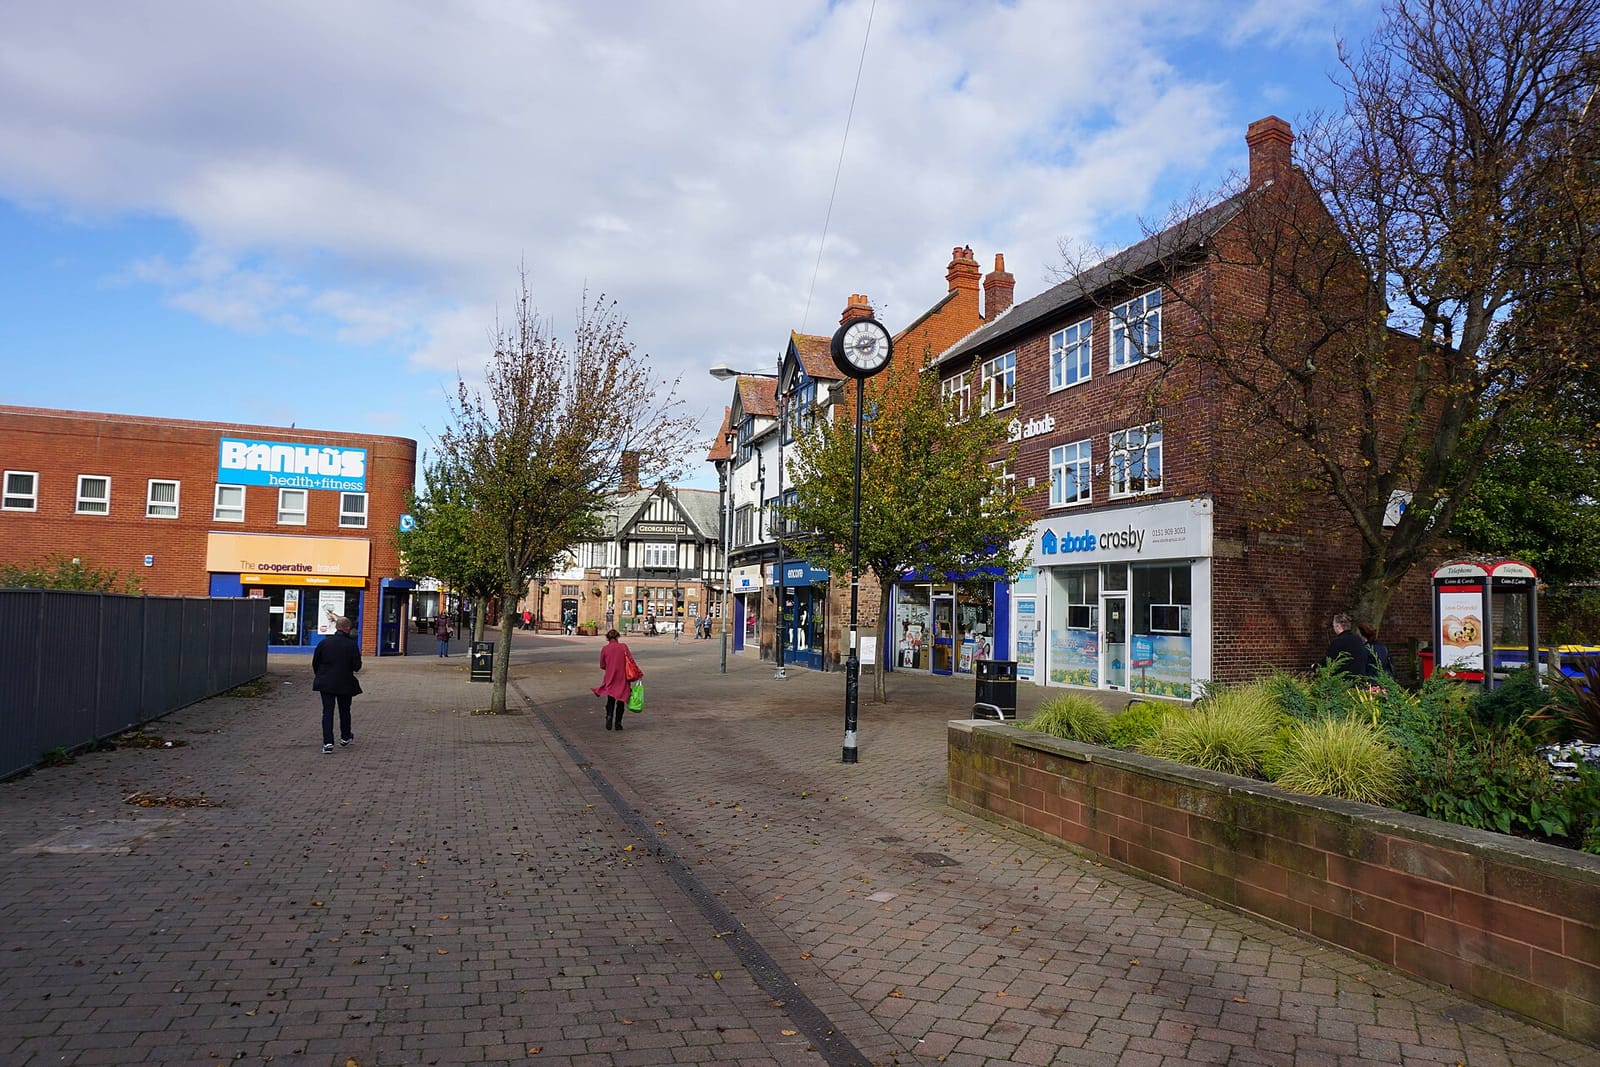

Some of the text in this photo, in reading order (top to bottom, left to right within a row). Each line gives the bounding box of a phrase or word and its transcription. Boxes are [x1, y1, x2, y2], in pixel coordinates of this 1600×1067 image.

[1023, 413, 1055, 438] abode
[269, 474, 363, 490] health+fitness
[639, 525, 664, 533] GEORGE
[1060, 529, 1097, 554] abode
[1099, 524, 1145, 553] crosby
[240, 560, 255, 570] The
[258, 562, 312, 573] co-operative
